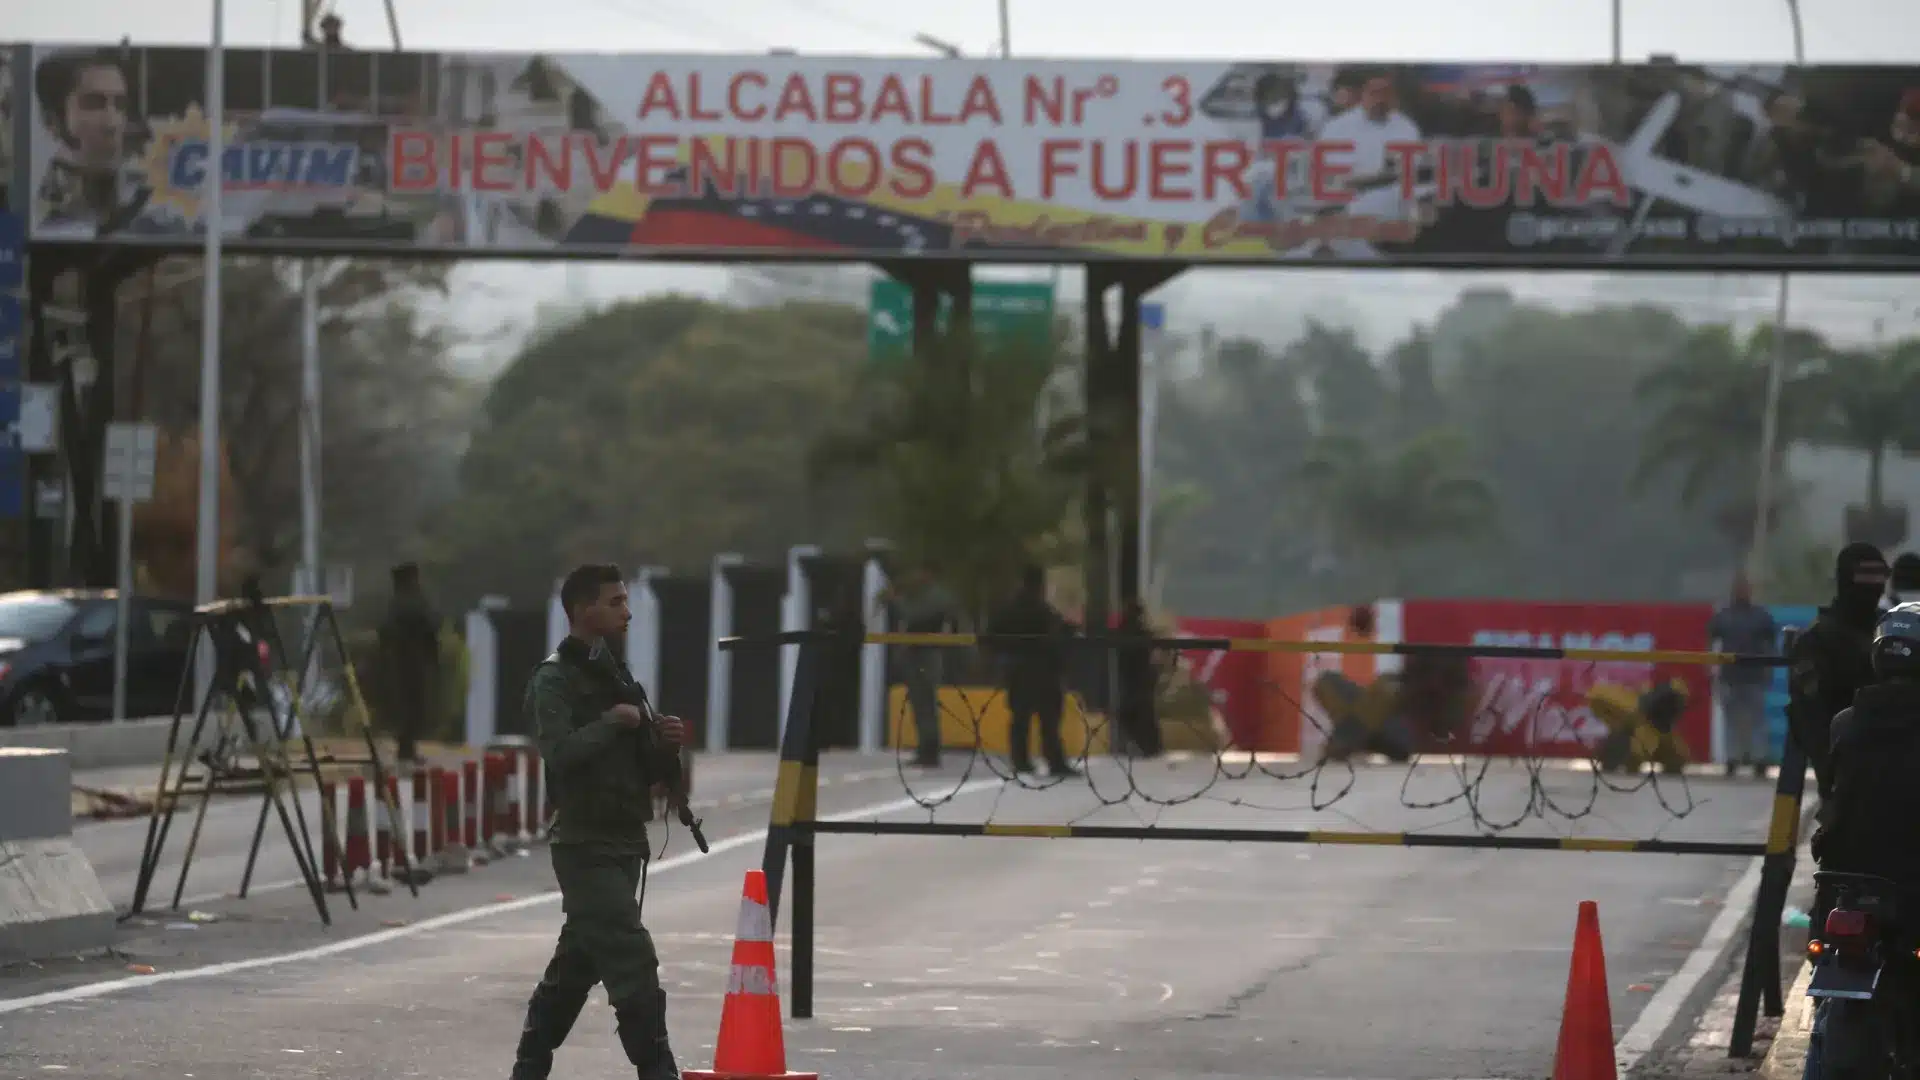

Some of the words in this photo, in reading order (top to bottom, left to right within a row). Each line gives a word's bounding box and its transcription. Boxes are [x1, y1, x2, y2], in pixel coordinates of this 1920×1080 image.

[639, 70, 1001, 124] ALCABALA
[170, 142, 356, 187] CAVIM
[391, 131, 934, 198] BIENVENIDOS
[961, 138, 1014, 198] A
[1041, 140, 1356, 201] FUERTE
[1385, 141, 1630, 204] TIUNA
